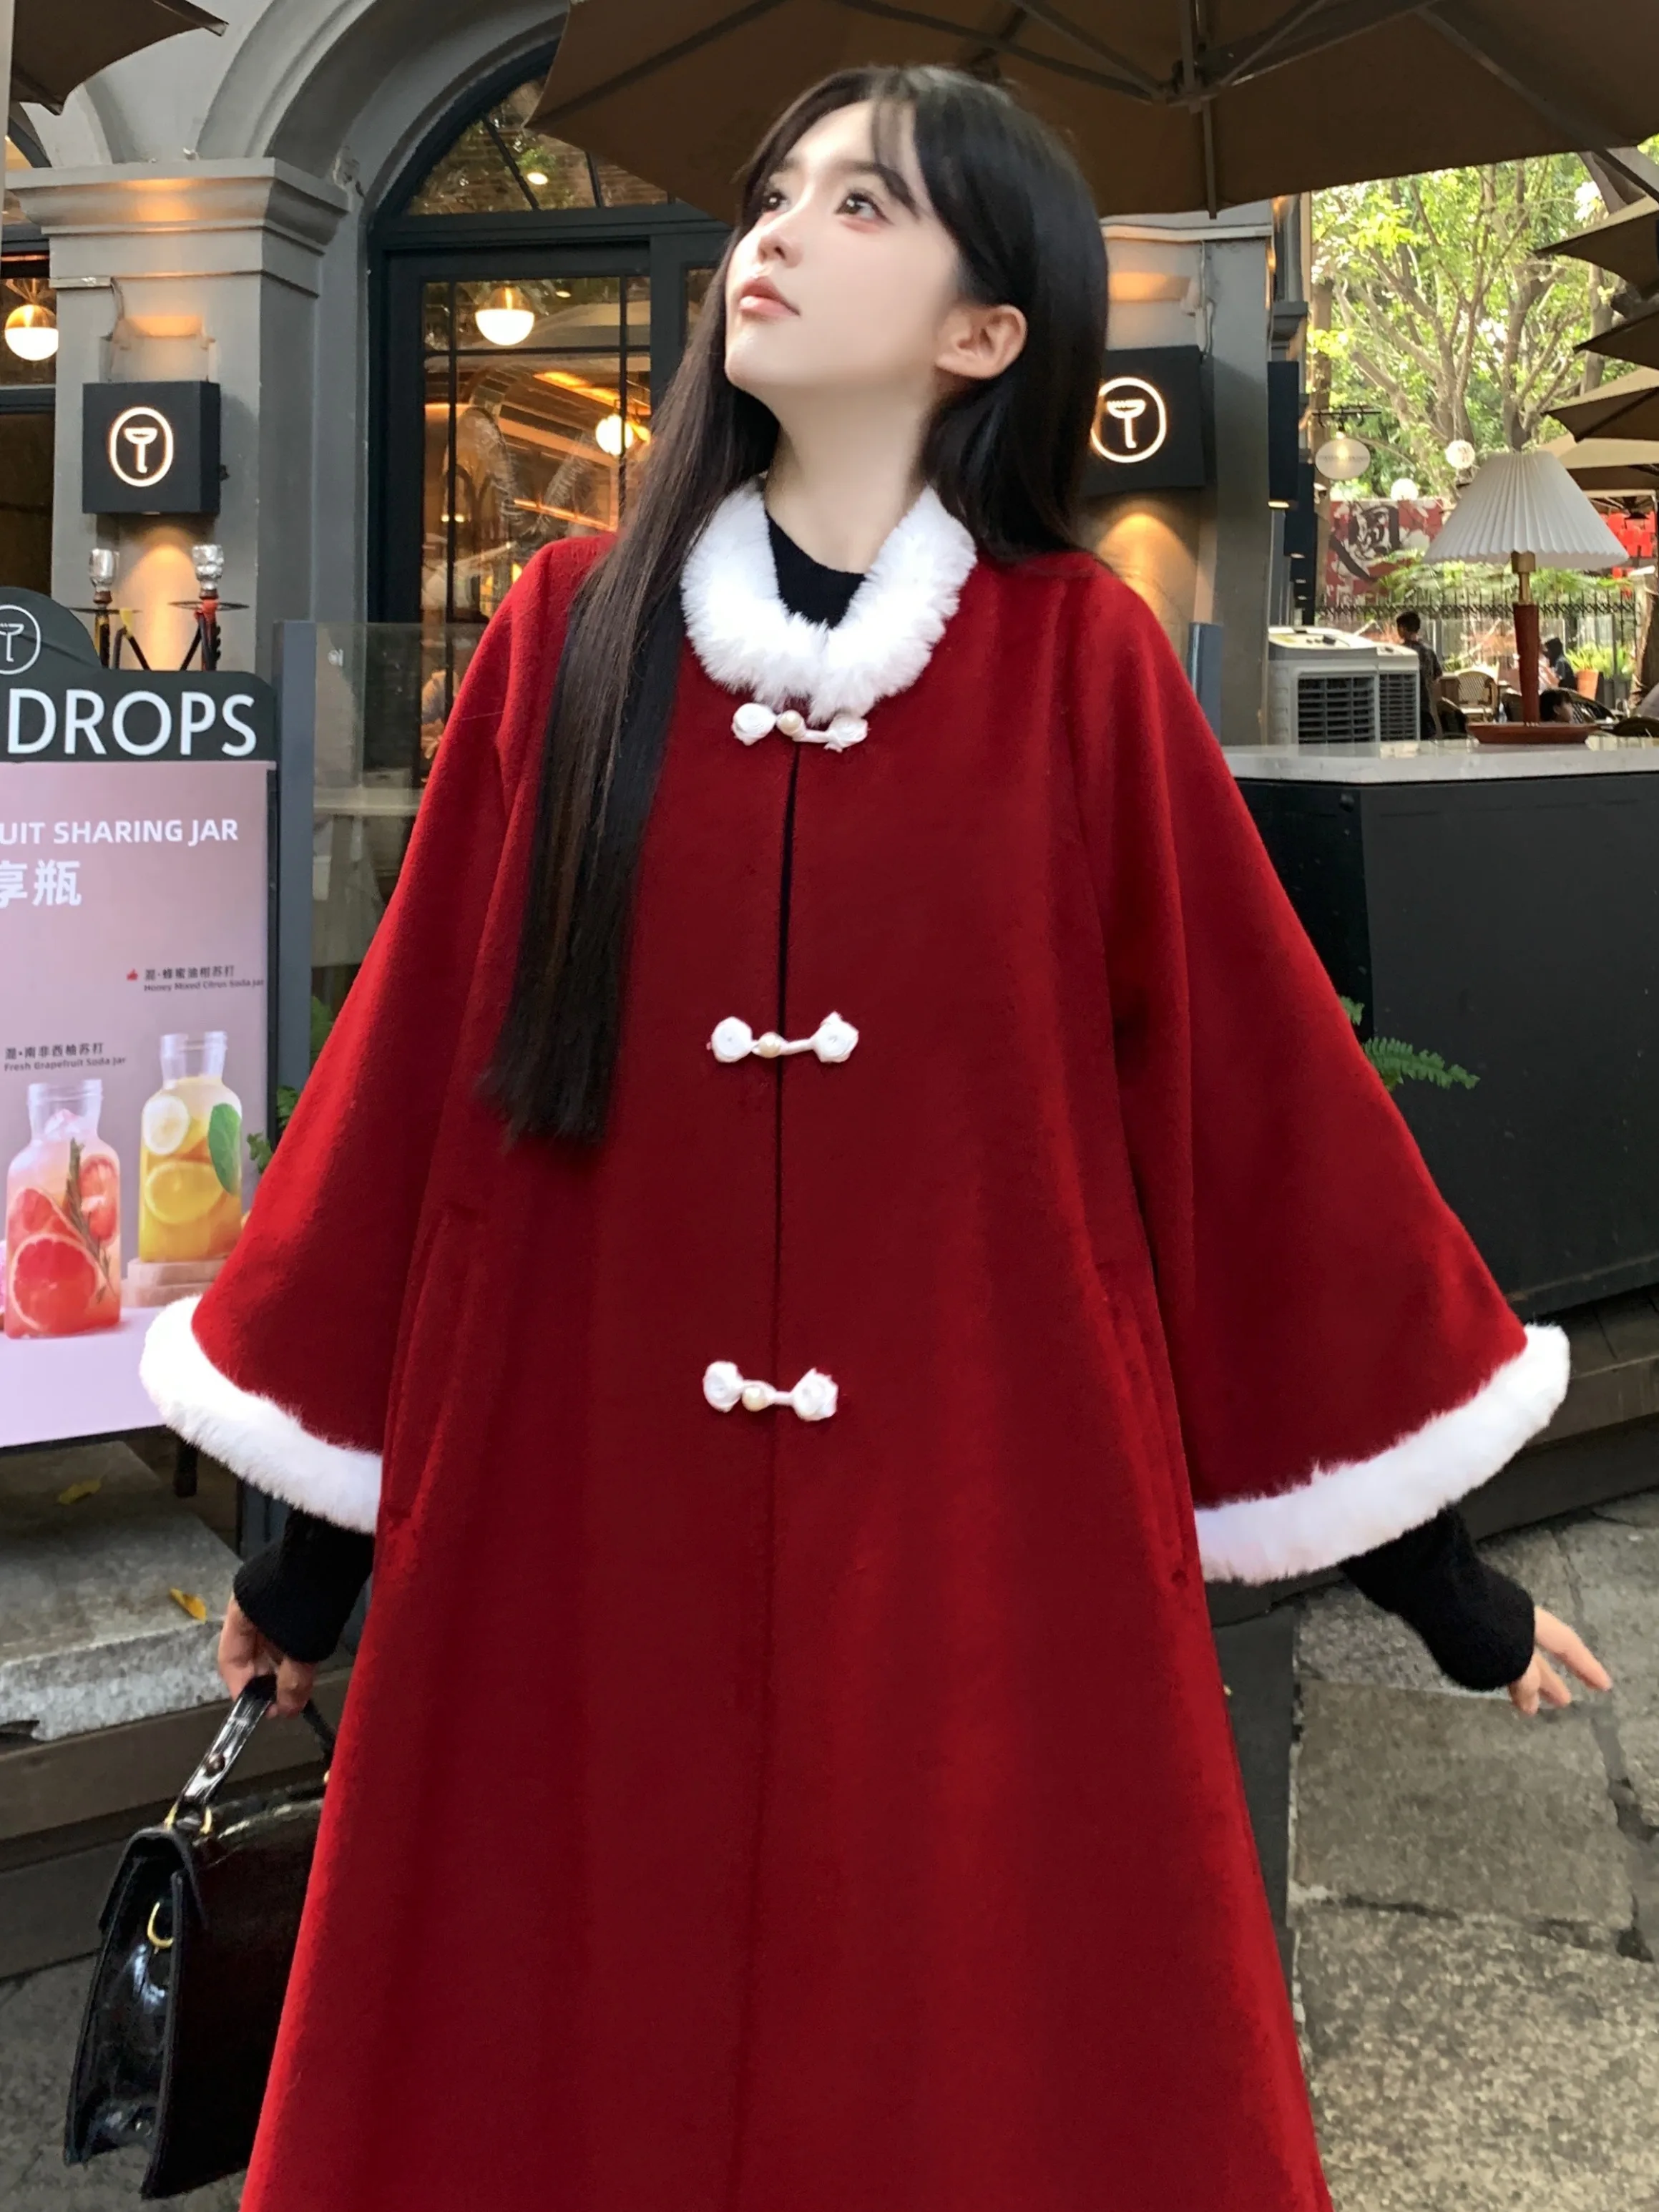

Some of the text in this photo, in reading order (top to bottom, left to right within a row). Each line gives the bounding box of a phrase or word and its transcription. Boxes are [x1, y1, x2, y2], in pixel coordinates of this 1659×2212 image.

[7, 687, 258, 757] DROPS
[0, 818, 239, 846] UIT SHARING JAR
[0, 858, 82, 909] 享瓶
[4, 1062, 31, 1072] Fresh
[34, 1059, 84, 1070] Grapefruit
[86, 1057, 110, 1067] Soda
